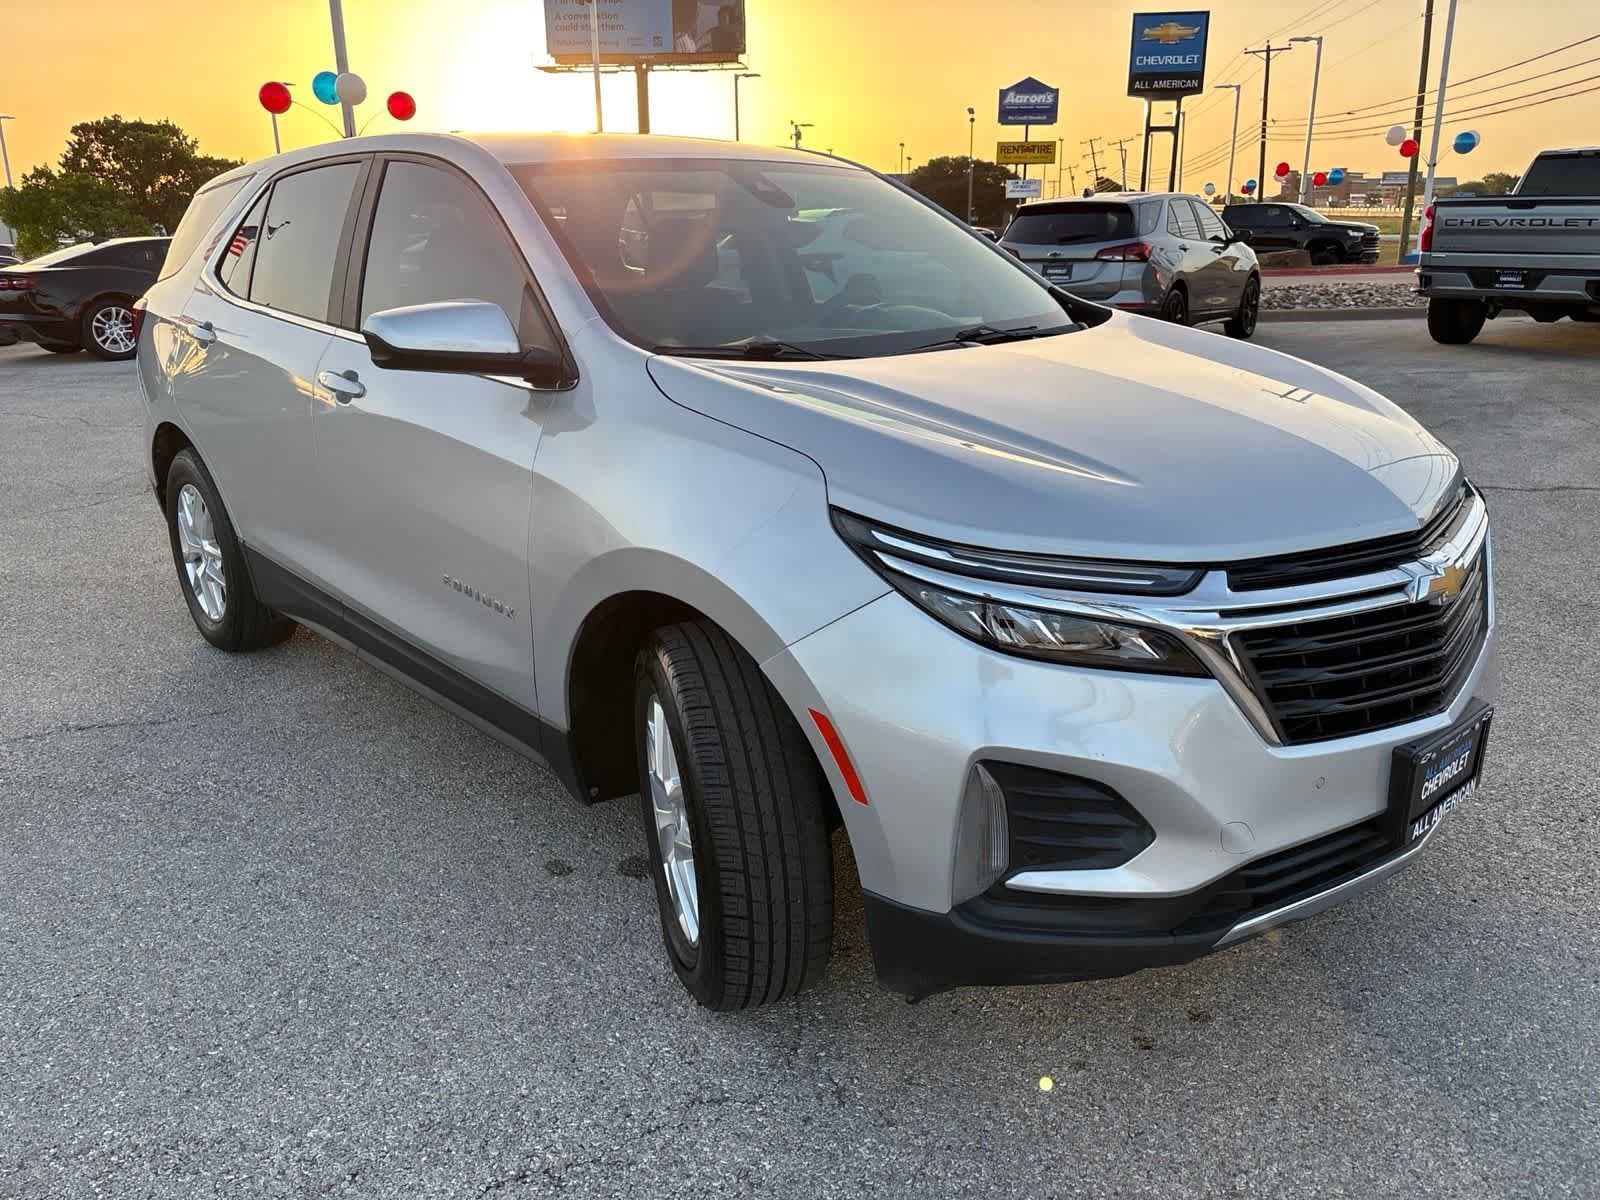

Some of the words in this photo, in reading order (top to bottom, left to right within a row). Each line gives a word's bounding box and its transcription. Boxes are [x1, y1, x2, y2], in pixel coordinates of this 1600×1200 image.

[1136, 55, 1200, 65] CHEVROLET
[1135, 81, 1150, 89] ALL
[1153, 80, 1199, 89] AMERICAN
[1003, 91, 1054, 104] Aaron's
[1444, 218, 1599, 228] CHEVROLET
[1421, 750, 1470, 800] CHEVROLET
[1411, 815, 1430, 841] ALL
[1431, 777, 1476, 824] AMERICAN
